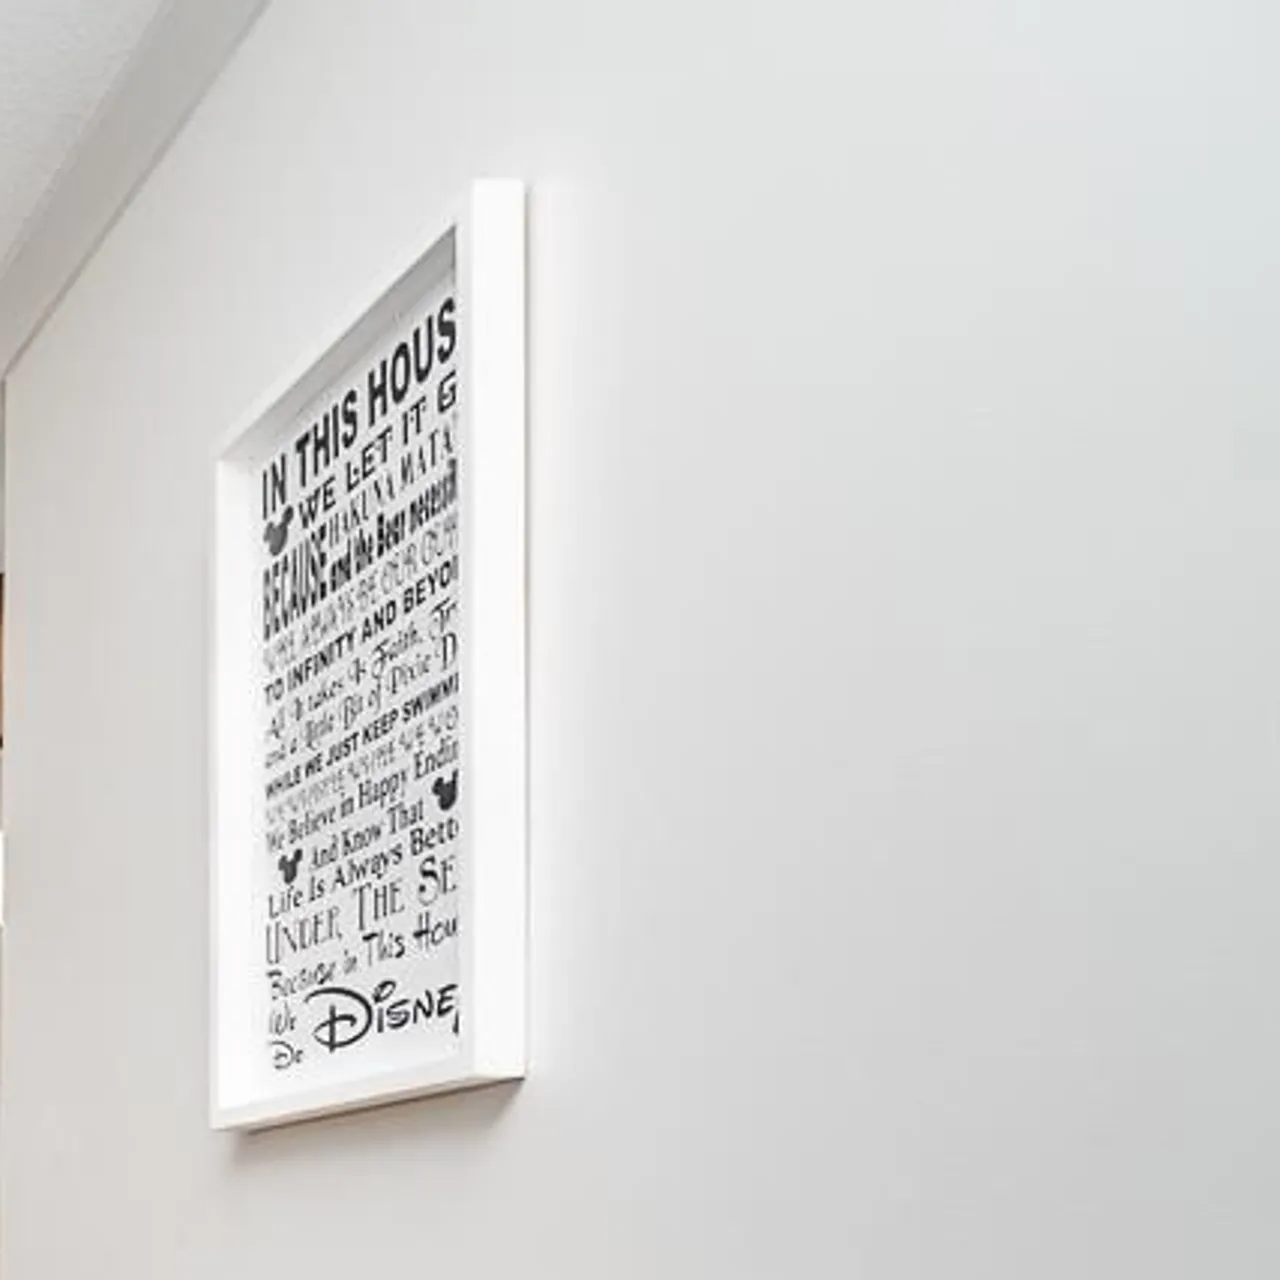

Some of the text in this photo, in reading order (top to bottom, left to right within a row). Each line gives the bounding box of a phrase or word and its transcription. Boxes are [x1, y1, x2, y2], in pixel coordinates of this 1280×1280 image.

[263, 453, 286, 521] IN
[296, 389, 357, 487] THIS
[299, 475, 336, 529] WE
[346, 425, 393, 493] LET
[402, 395, 427, 446] IT
[264, 523, 326, 640] BECAUSE
[264, 677, 284, 705] TO
[287, 626, 357, 692] INFINITY
[362, 600, 396, 643] AND
[306, 752, 322, 778] WE
[326, 732, 359, 766] JUST
[362, 708, 398, 745] KEEP
[359, 770, 407, 809] Happy
[310, 797, 424, 871] And Know That
[266, 905, 342, 965] UNDER
[354, 878, 405, 931] THE
[269, 886, 303, 919] Life
[310, 875, 325, 903] Is
[332, 843, 403, 892] Always
[362, 929, 405, 967] This
